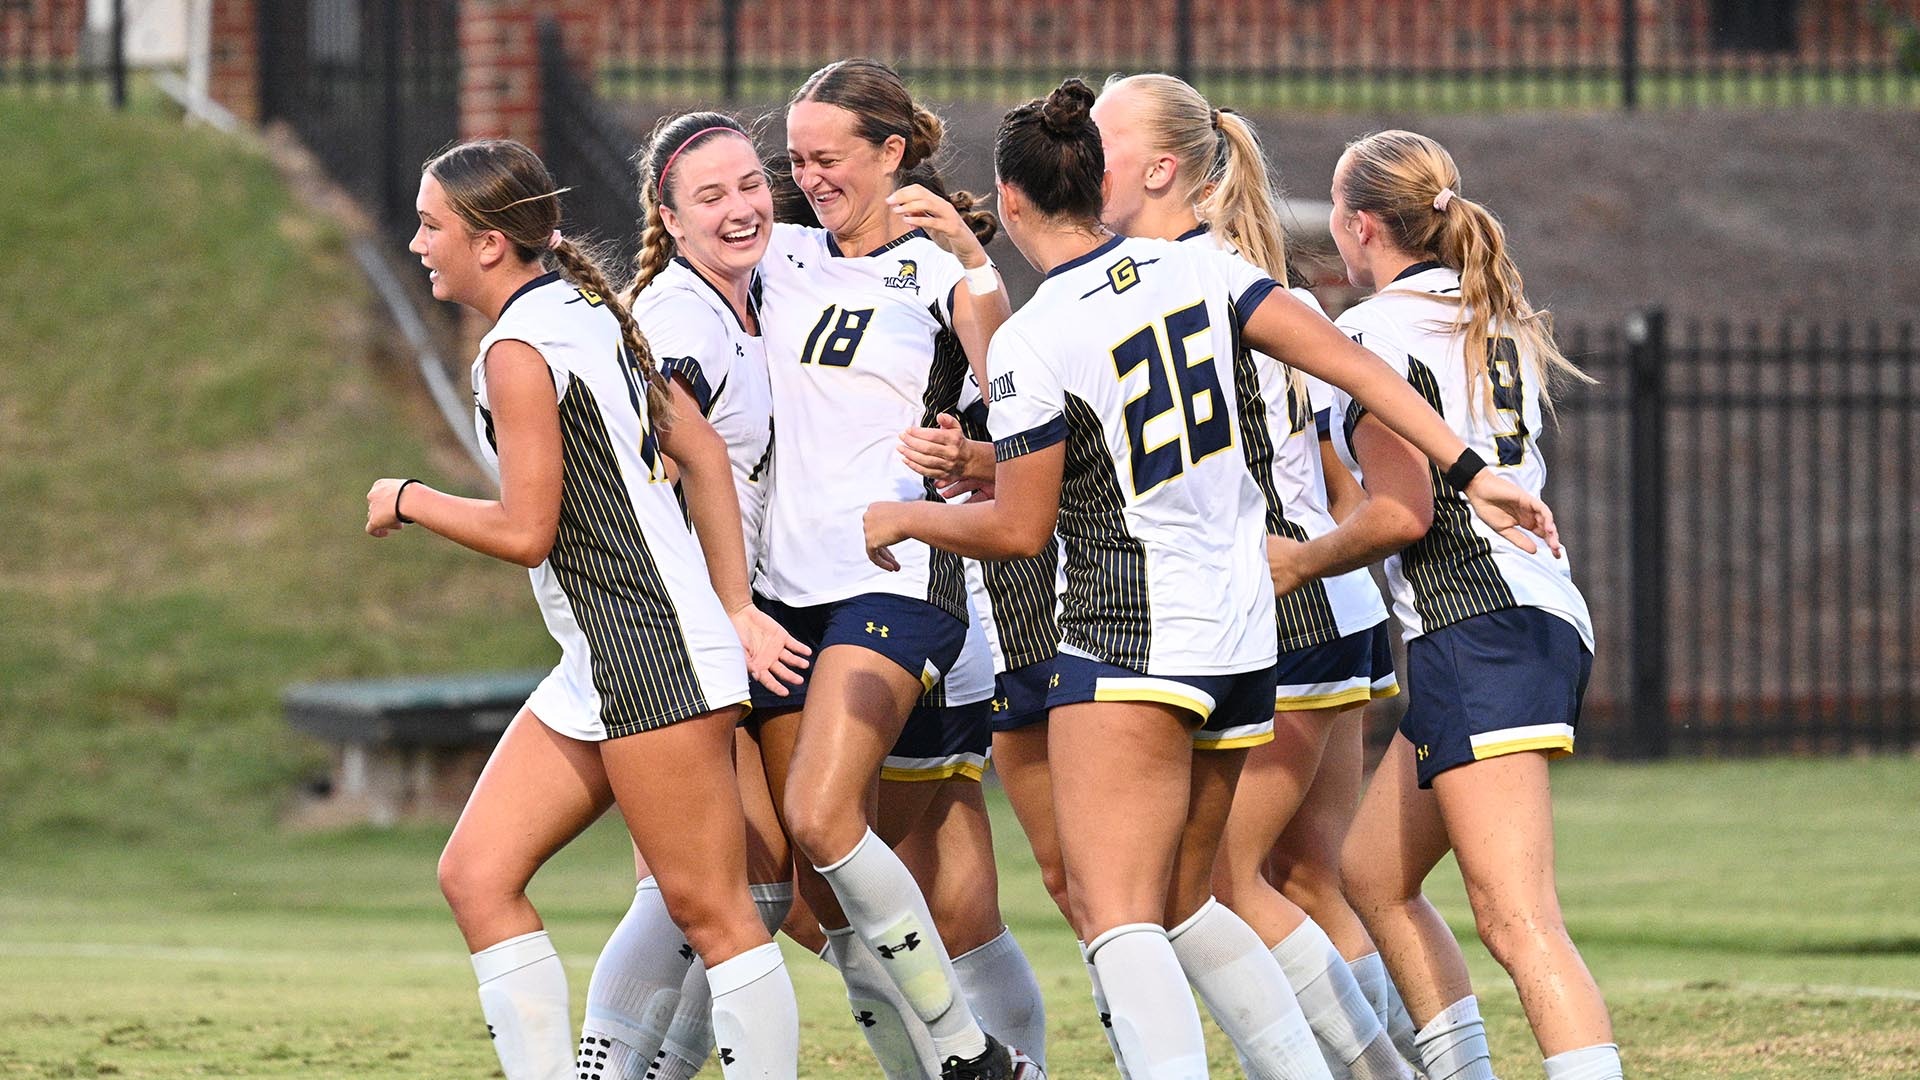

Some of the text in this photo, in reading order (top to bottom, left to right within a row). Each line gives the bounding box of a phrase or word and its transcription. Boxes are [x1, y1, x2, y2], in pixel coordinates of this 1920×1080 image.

[1106, 255, 1141, 294] G
[800, 303, 876, 368] 18
[1108, 299, 1235, 499] 26
[1485, 335, 1530, 468] 9
